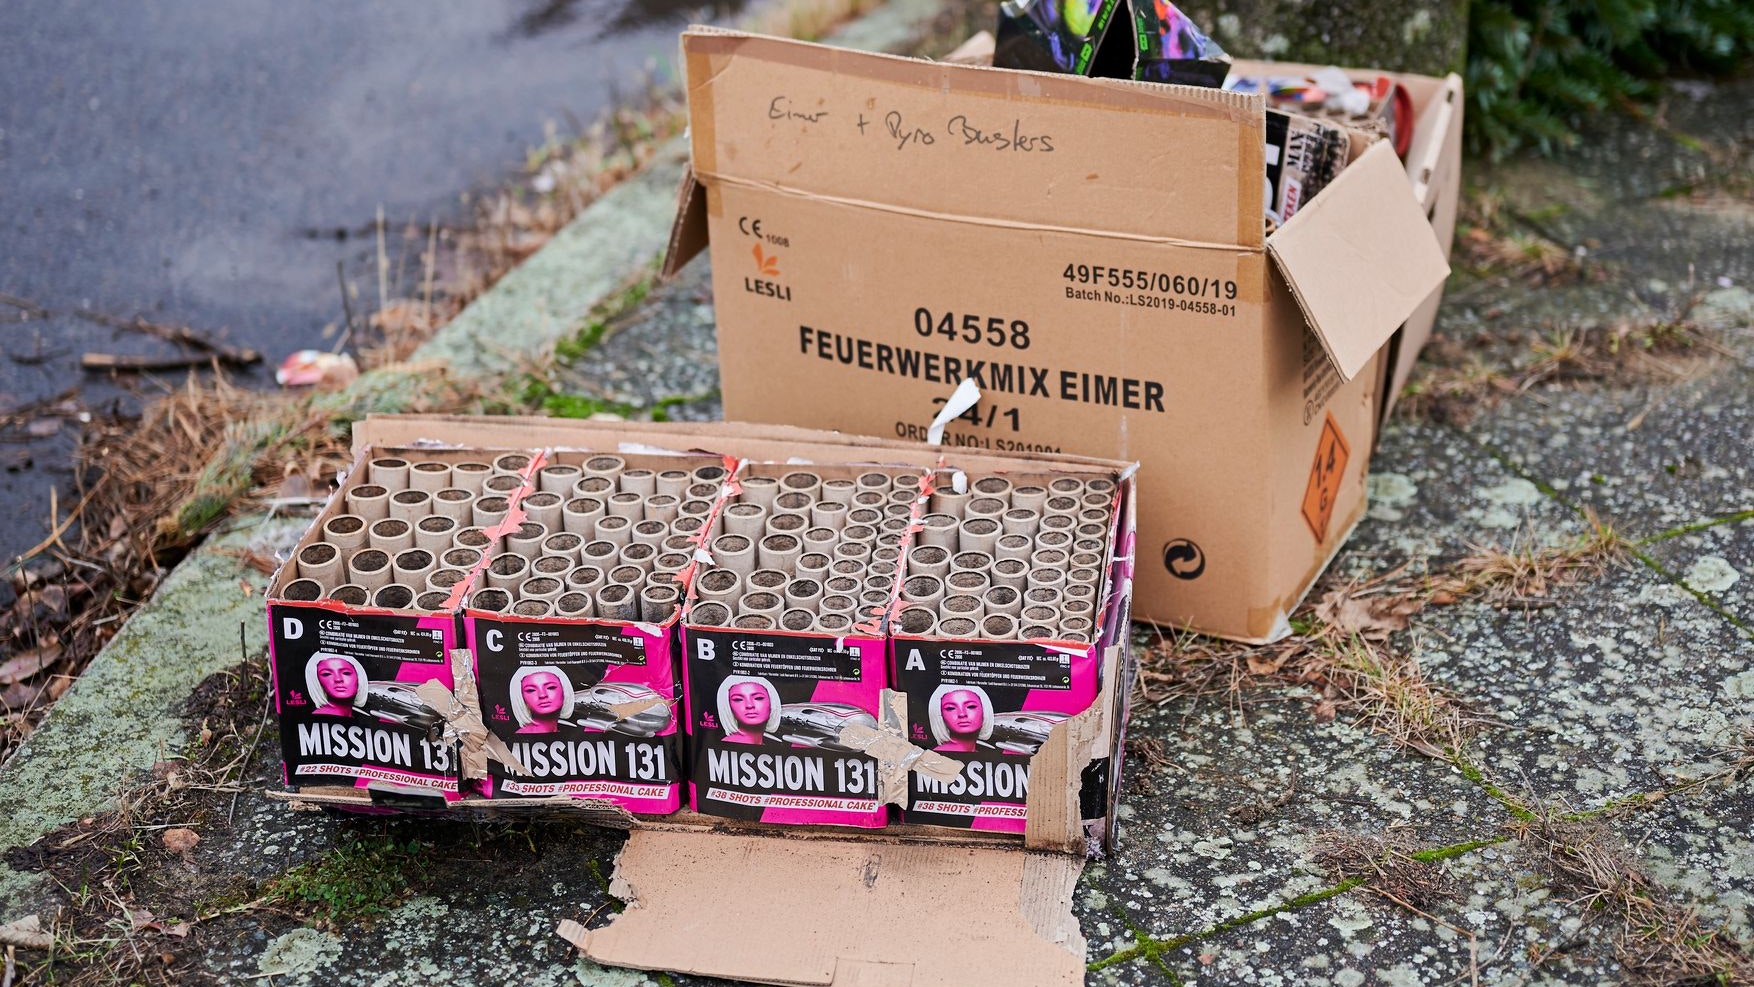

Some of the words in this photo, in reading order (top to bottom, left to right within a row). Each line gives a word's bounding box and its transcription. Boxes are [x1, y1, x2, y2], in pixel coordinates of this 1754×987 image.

[857, 114, 869, 135] +
[886, 111, 935, 150] Pyro
[744, 277, 791, 301] LESLI
[1063, 263, 1237, 300] 49F555/060/19
[1066, 287, 1101, 301] Batch
[914, 308, 1030, 350] 04558
[800, 325, 1049, 397] FEUERWERKMIX
[1060, 371, 1164, 412] EIMER
[896, 421, 950, 445] ORDR
[283, 617, 304, 640] D
[486, 629, 504, 652] C
[697, 638, 716, 661] B
[905, 648, 926, 671] A
[286, 698, 306, 706] LESLI
[699, 720, 719, 729] LESLI
[298, 723, 412, 767] MISSION
[625, 742, 666, 780] 131
[708, 749, 825, 791] MISSION
[834, 758, 876, 794] 131
[299, 765, 320, 774] #22
[320, 765, 352, 775] SHOTS
[354, 768, 428, 786] #PROFESSIONAL
[431, 779, 457, 790] CAKE
[521, 784, 555, 793] SHOTS
[558, 783, 635, 796] #PROFESSIONAL
[637, 786, 665, 797] CAKE
[710, 790, 727, 799] #38
[729, 792, 761, 804] SHOTS
[764, 796, 844, 809] #PROFESSIONAL
[846, 801, 876, 811] CAKE
[917, 803, 935, 811] #38
[936, 804, 971, 814] SHOTS
